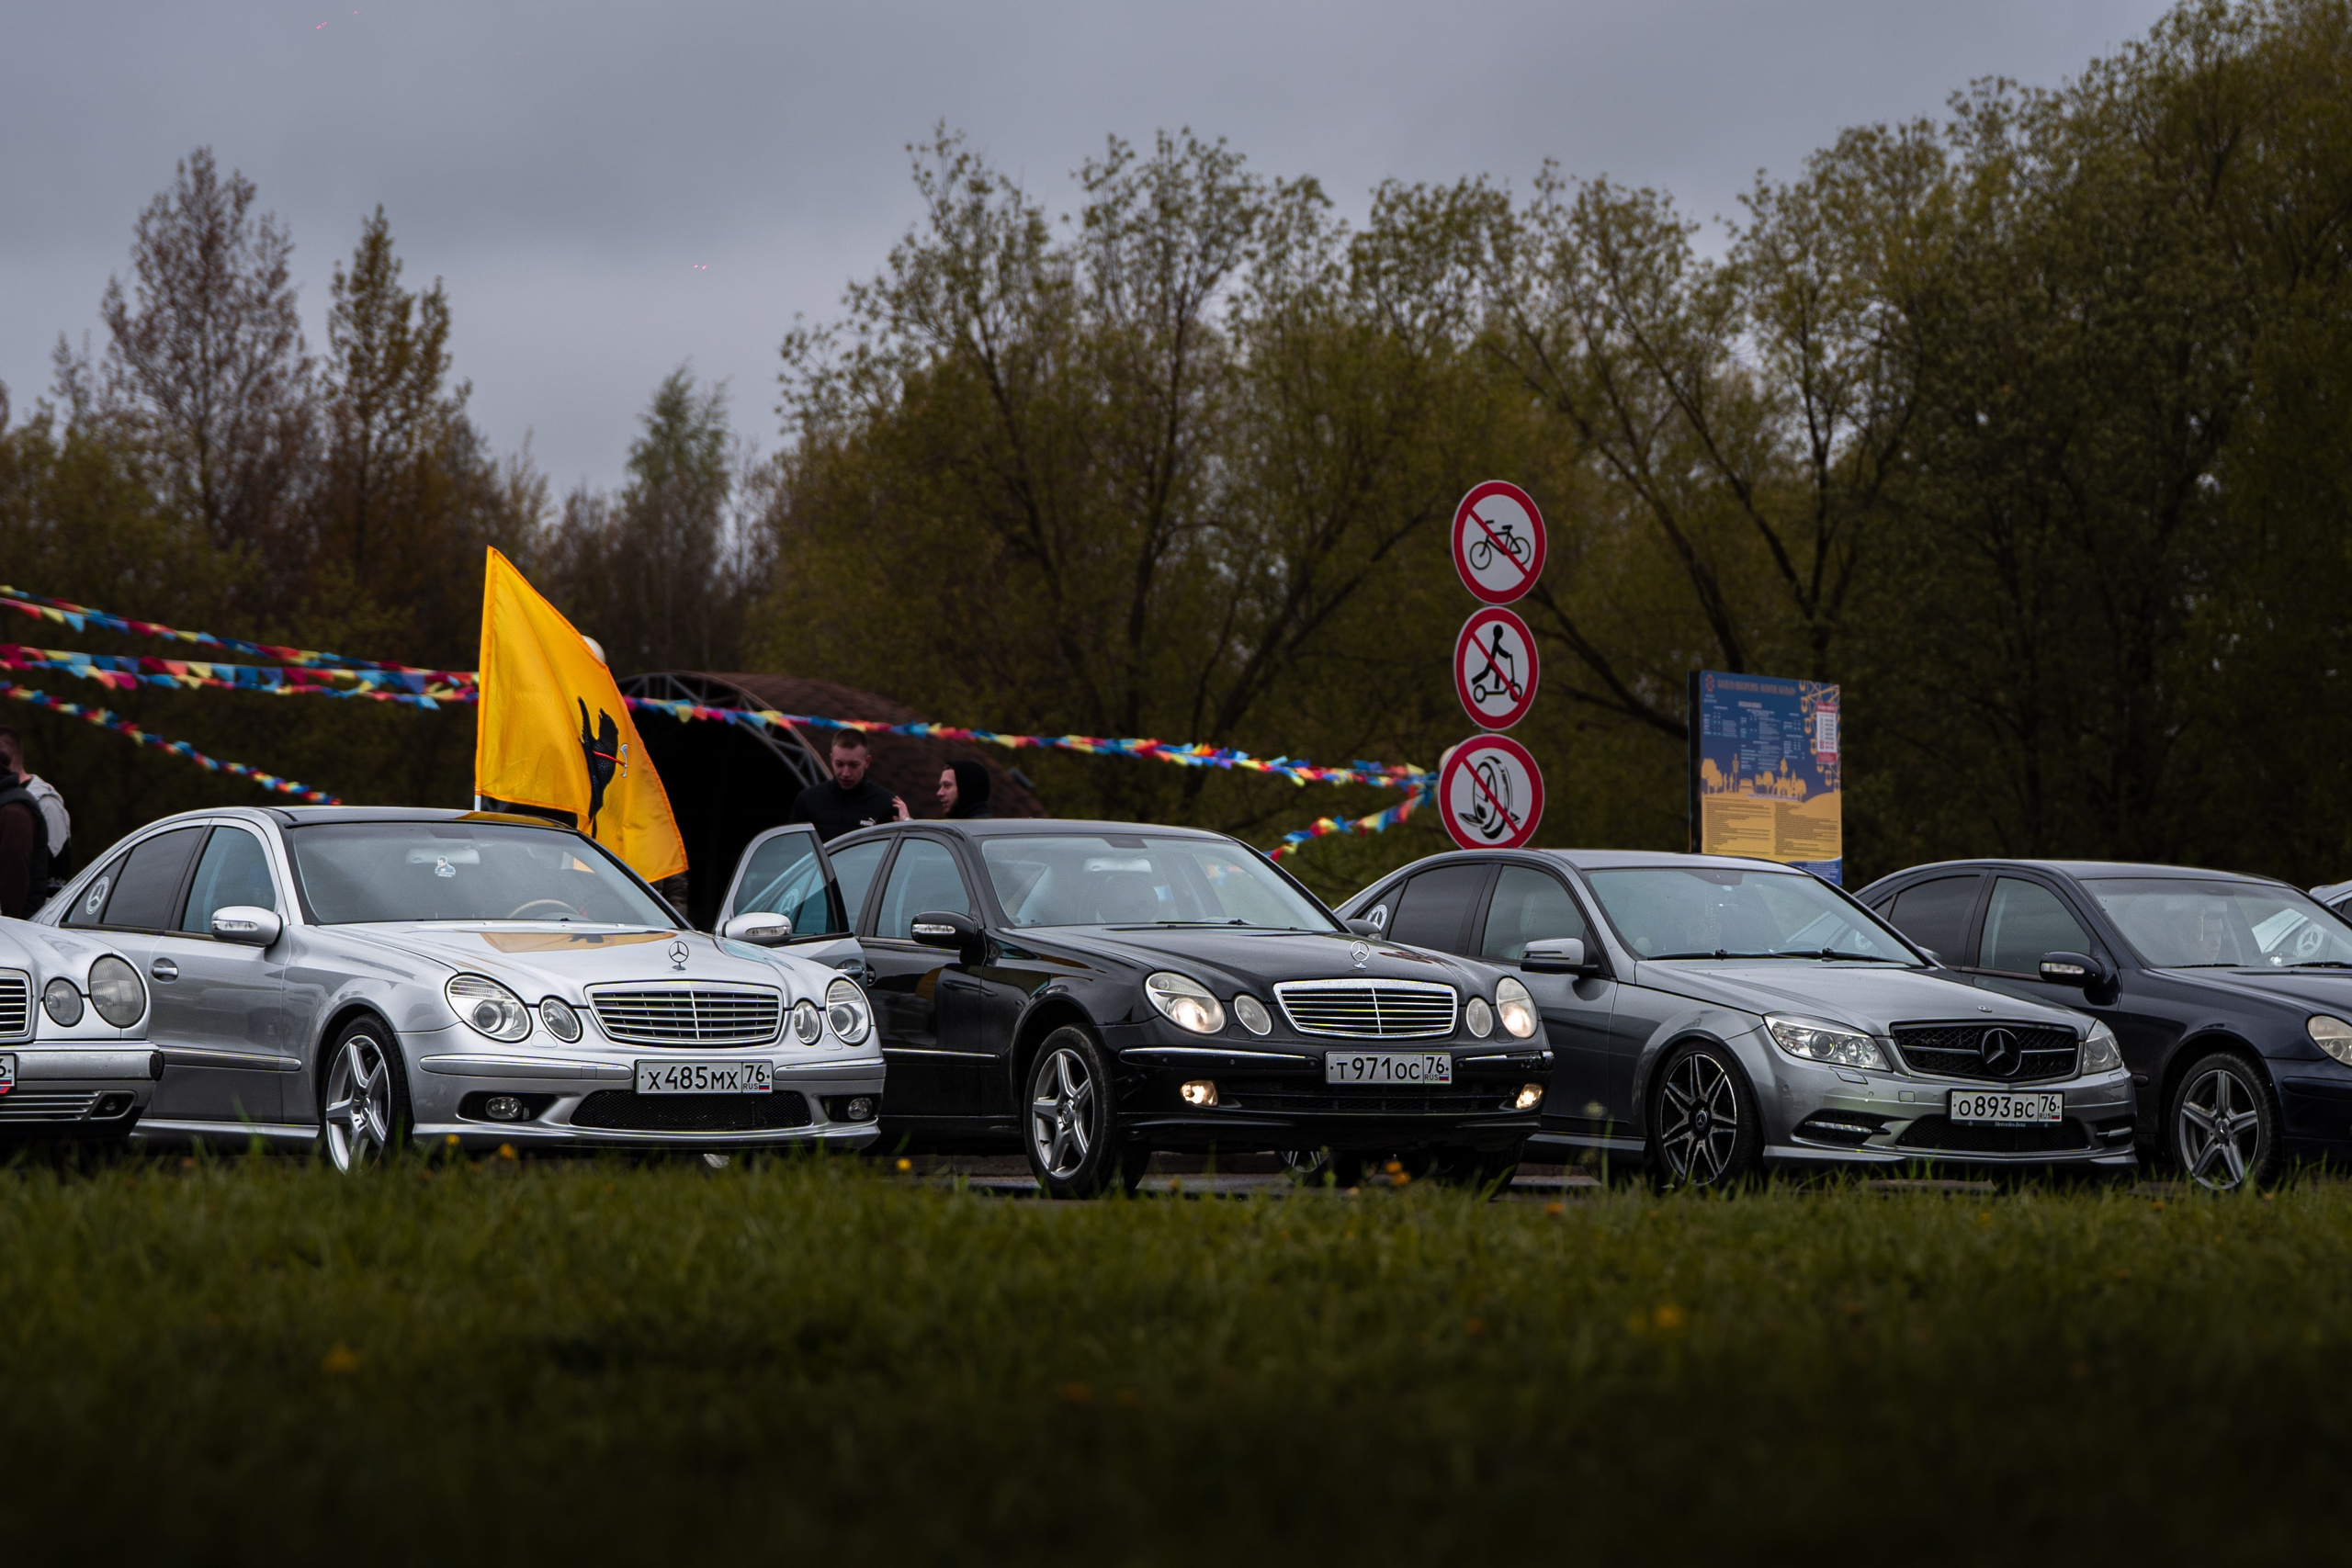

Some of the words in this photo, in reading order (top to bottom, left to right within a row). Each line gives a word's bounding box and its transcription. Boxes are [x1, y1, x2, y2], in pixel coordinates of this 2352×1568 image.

[744, 1065, 765, 1083] 76
[1425, 1056, 1444, 1074] 76
[2041, 1095, 2057, 1112] 76
